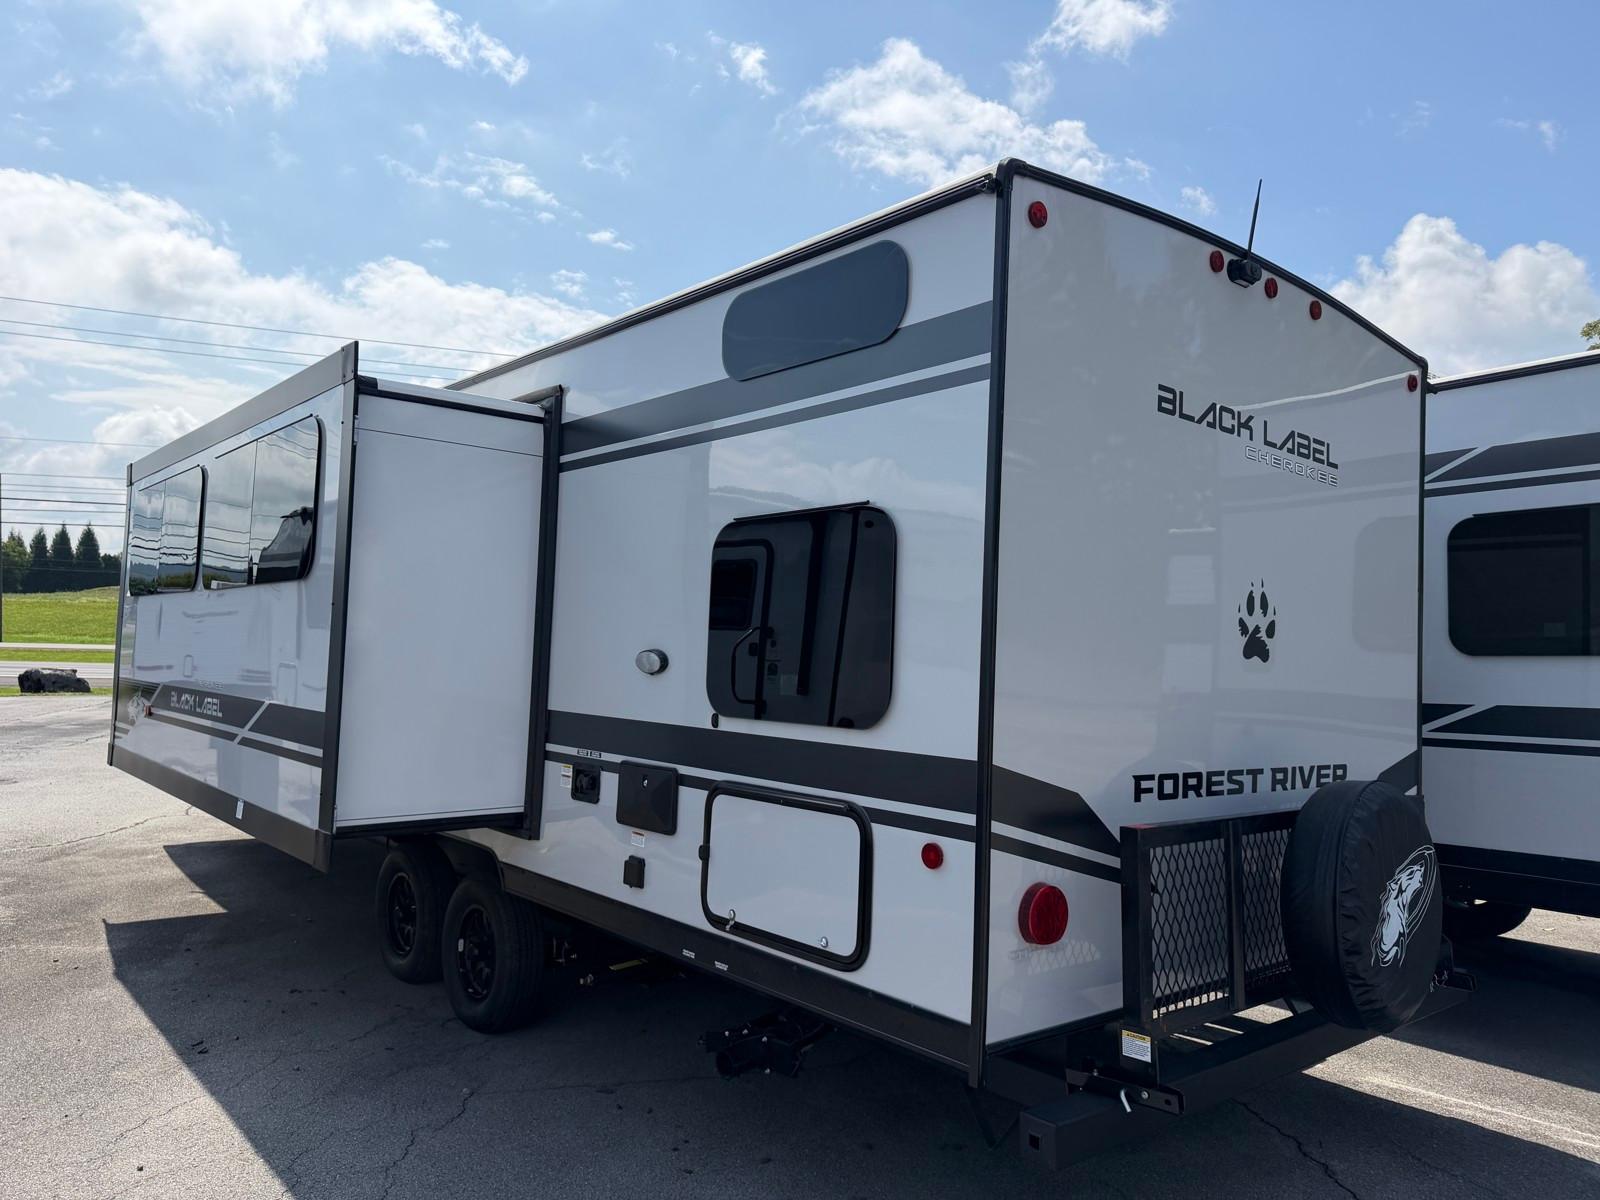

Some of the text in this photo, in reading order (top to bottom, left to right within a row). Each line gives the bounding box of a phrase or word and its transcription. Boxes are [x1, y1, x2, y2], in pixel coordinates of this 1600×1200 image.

[1157, 383, 1339, 469] BLACK LABEL
[1245, 445, 1339, 487] CHEROKEE
[170, 691, 223, 718] BLACK LABEL
[1131, 763, 1348, 803] FOREST RIVER
